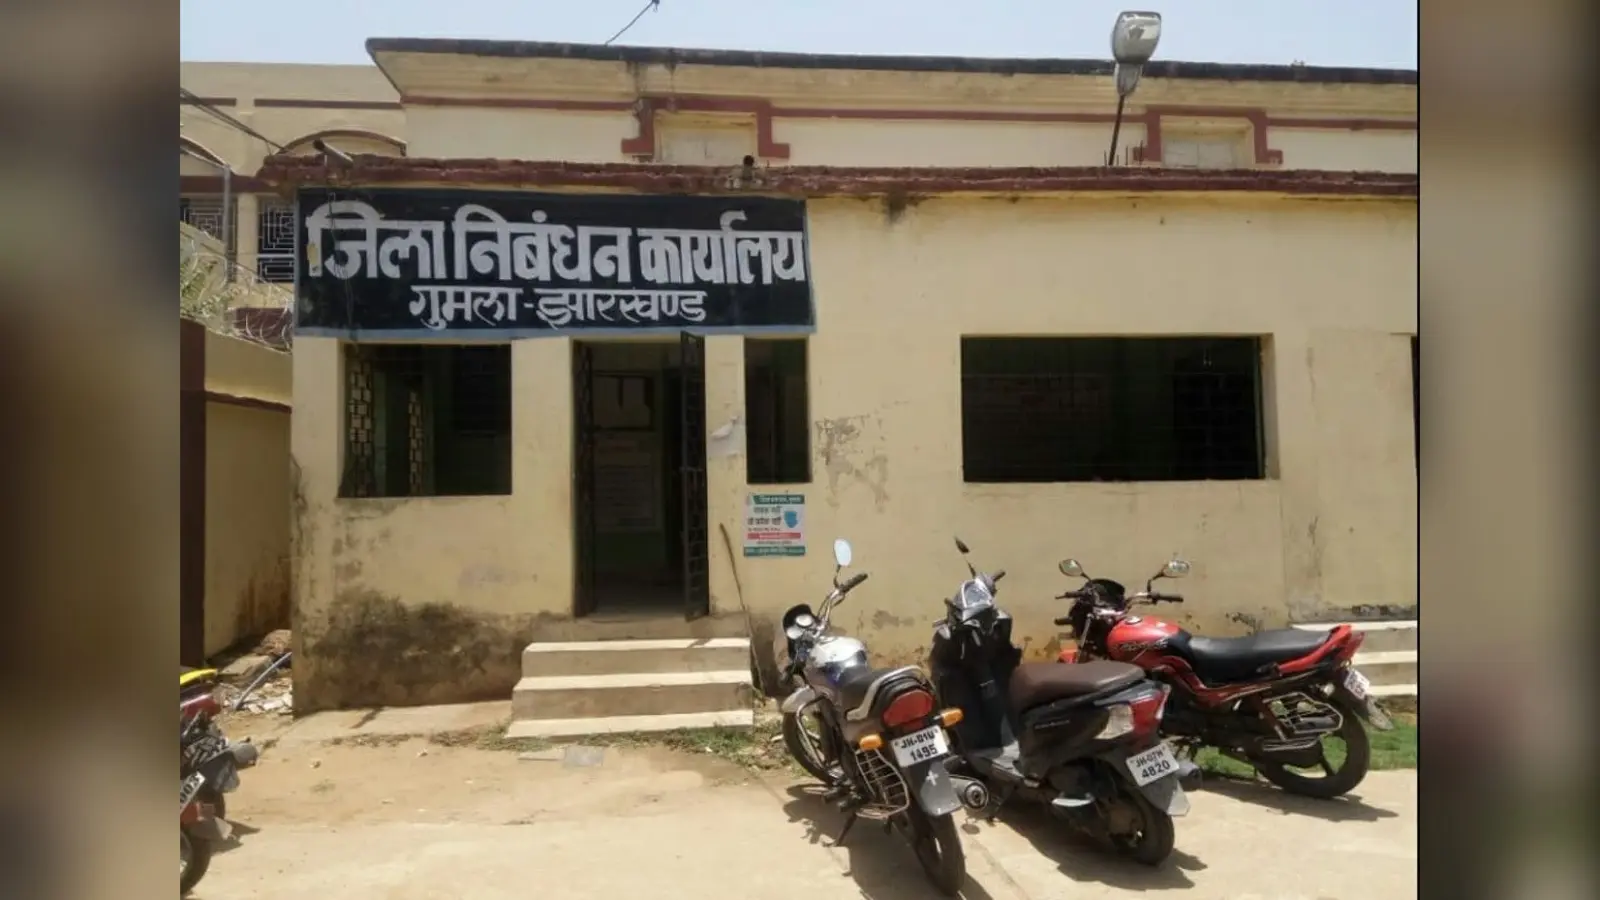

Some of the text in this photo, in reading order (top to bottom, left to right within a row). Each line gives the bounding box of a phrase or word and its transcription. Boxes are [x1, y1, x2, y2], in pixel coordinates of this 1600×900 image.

[305, 200, 806, 284] जिला निबंधन कार्यालय
[910, 743, 938, 761] 1495
[1142, 759, 1171, 778] 4820
